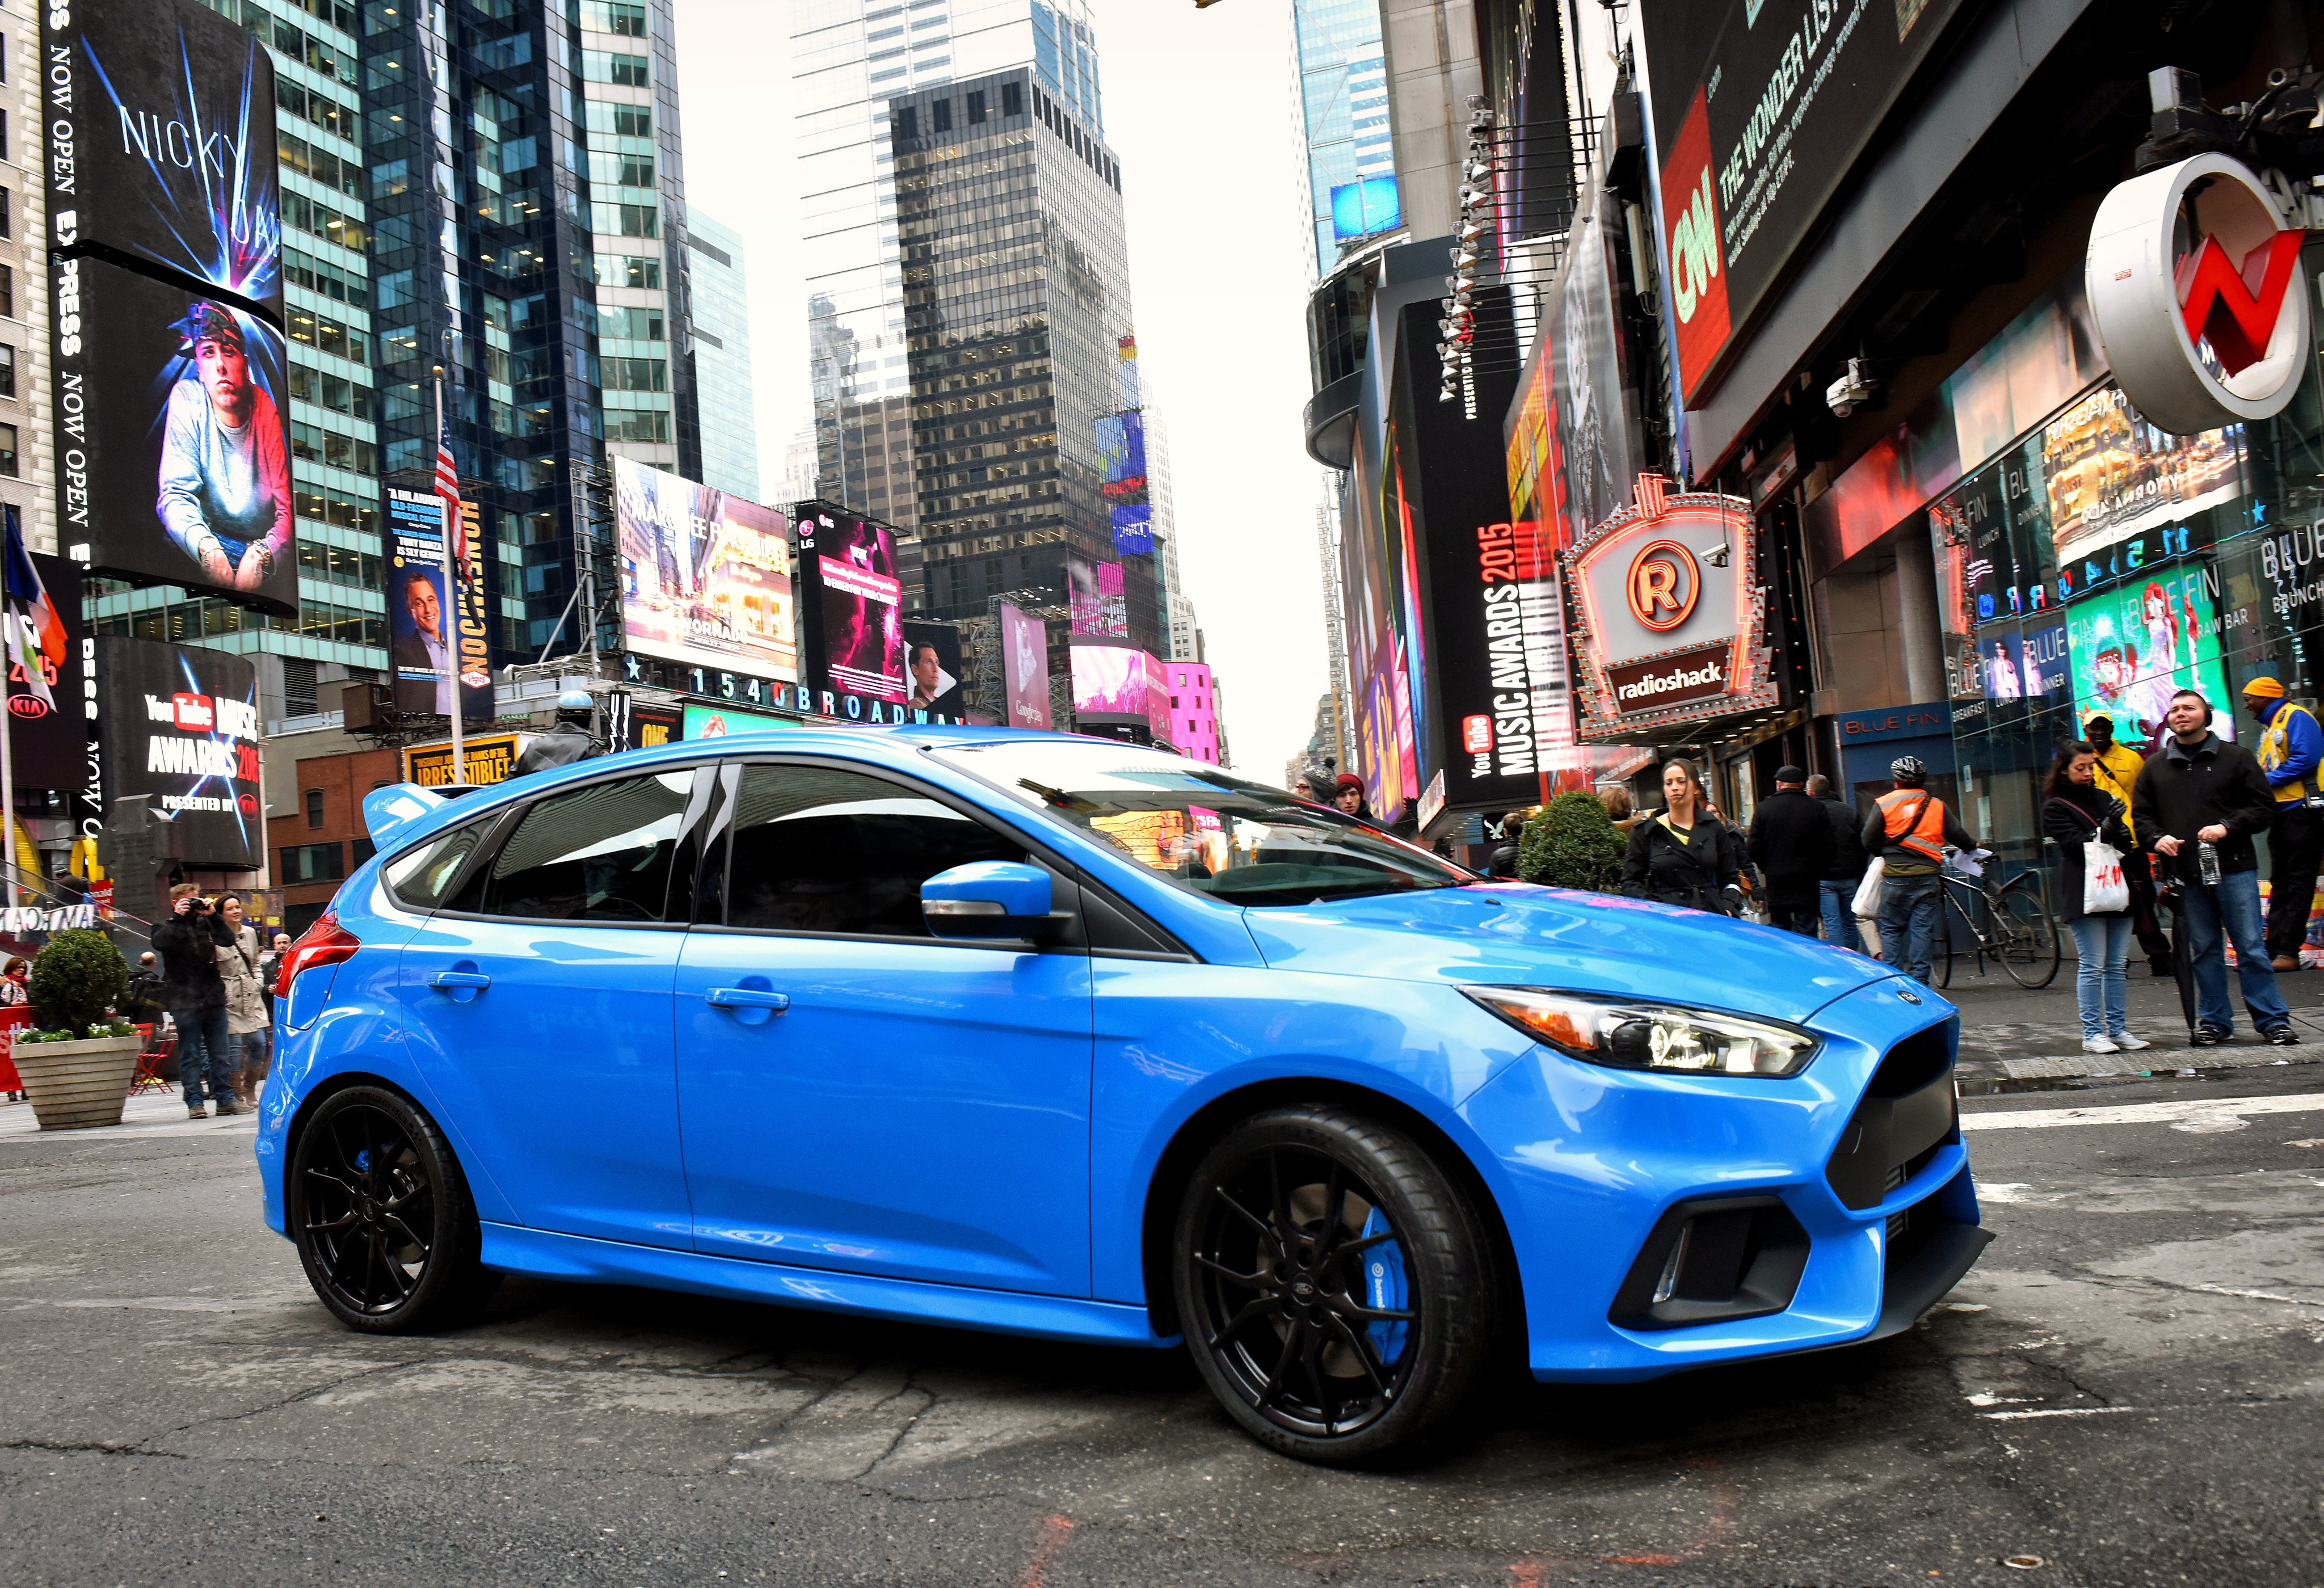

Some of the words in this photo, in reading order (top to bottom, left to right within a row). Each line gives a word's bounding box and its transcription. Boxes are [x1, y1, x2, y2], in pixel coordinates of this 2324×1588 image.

[50, 44, 73, 113] NOW
[1719, 142, 1745, 211] THE
[1742, 32, 1804, 169] WONDER
[1803, 0, 1838, 60] LIS
[52, 119, 75, 195] OPEN
[119, 106, 245, 182] NICKY
[1672, 165, 1718, 323] CNN
[62, 371, 85, 443] NOW
[65, 449, 88, 527] OPEN
[390, 500, 442, 517] OLD-FASHIONE
[801, 538, 815, 549] LG
[1477, 523, 1517, 583] 2015
[2261, 518, 2324, 579] BLUE
[2186, 564, 2221, 608] FIN
[2272, 580, 2324, 613] BRUNCH
[684, 618, 750, 645] VORNADO
[1484, 584, 1528, 690] AWARDS
[2197, 617, 2221, 639] RAW
[2225, 608, 2249, 629] BAR
[2028, 627, 2066, 667] BLUE
[1618, 662, 1723, 700] radioshack
[1950, 663, 1981, 697] BLUE
[12, 698, 41, 714] KIA
[144, 694, 212, 726] YouTube
[798, 686, 965, 726] BROADWAY
[1845, 716, 1901, 735] BLUE
[1906, 713, 1939, 726] FIN
[1952, 701, 1985, 722] BREAKFAST
[1468, 717, 1493, 778] YouTube
[1492, 694, 1534, 776] MUSIC
[148, 736, 238, 778] AWARDS
[162, 795, 221, 811] PRESENTED
